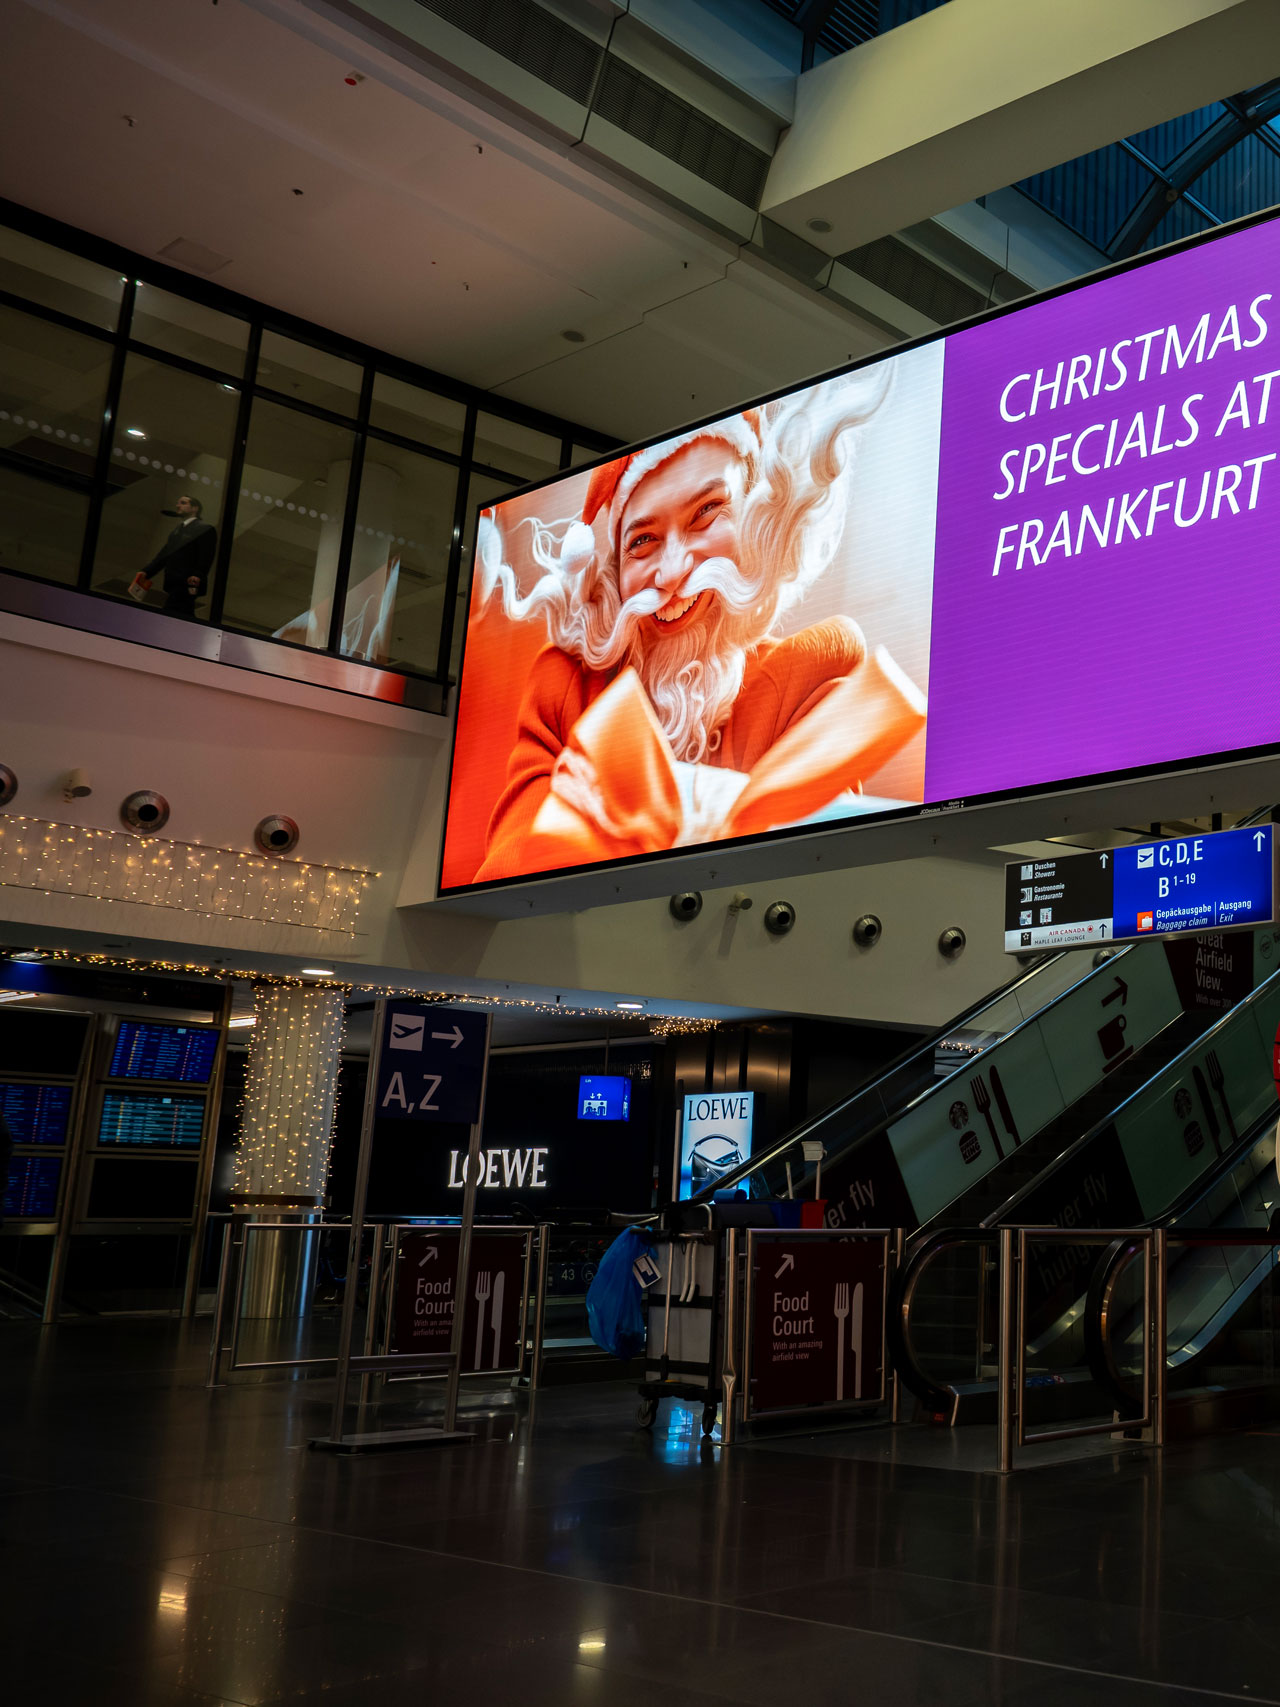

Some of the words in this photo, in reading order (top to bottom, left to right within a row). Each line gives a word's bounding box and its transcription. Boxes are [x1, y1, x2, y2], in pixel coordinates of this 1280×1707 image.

[1000, 294, 1272, 423] CHRISTMAS
[993, 394, 1204, 500] SPECIALS
[993, 453, 1276, 576] FRANKFURT
[1034, 862, 1056, 871] Duschen
[1034, 870, 1056, 879] Showers
[1034, 883, 1065, 893] Gastronomie
[1158, 876, 1170, 898] B
[1034, 892, 1063, 902] Restaurants
[1156, 904, 1212, 919] Gepäckausgabe
[1219, 899, 1252, 914] Ausgang
[1156, 917, 1186, 931] Baggage
[1188, 916, 1208, 926] claim
[1219, 914, 1234, 923] Exit
[1195, 946, 1233, 972] Airfield
[1196, 968, 1224, 992] View.
[1196, 992, 1208, 1004] With
[688, 1098, 748, 1121] LOEWE
[448, 1148, 549, 1188] LOEWE
[849, 1180, 875, 1211] fly
[1083, 1172, 1108, 1208] fly
[561, 1269, 576, 1281] 43
[416, 1277, 452, 1296] Food
[415, 1297, 456, 1315] Court
[774, 1290, 810, 1312] Food
[413, 1328, 434, 1336] airfield
[772, 1316, 814, 1336] Court
[772, 1341, 788, 1350] With
[798, 1340, 823, 1350] amazing
[772, 1352, 794, 1362] airfield
[796, 1352, 810, 1360] view
